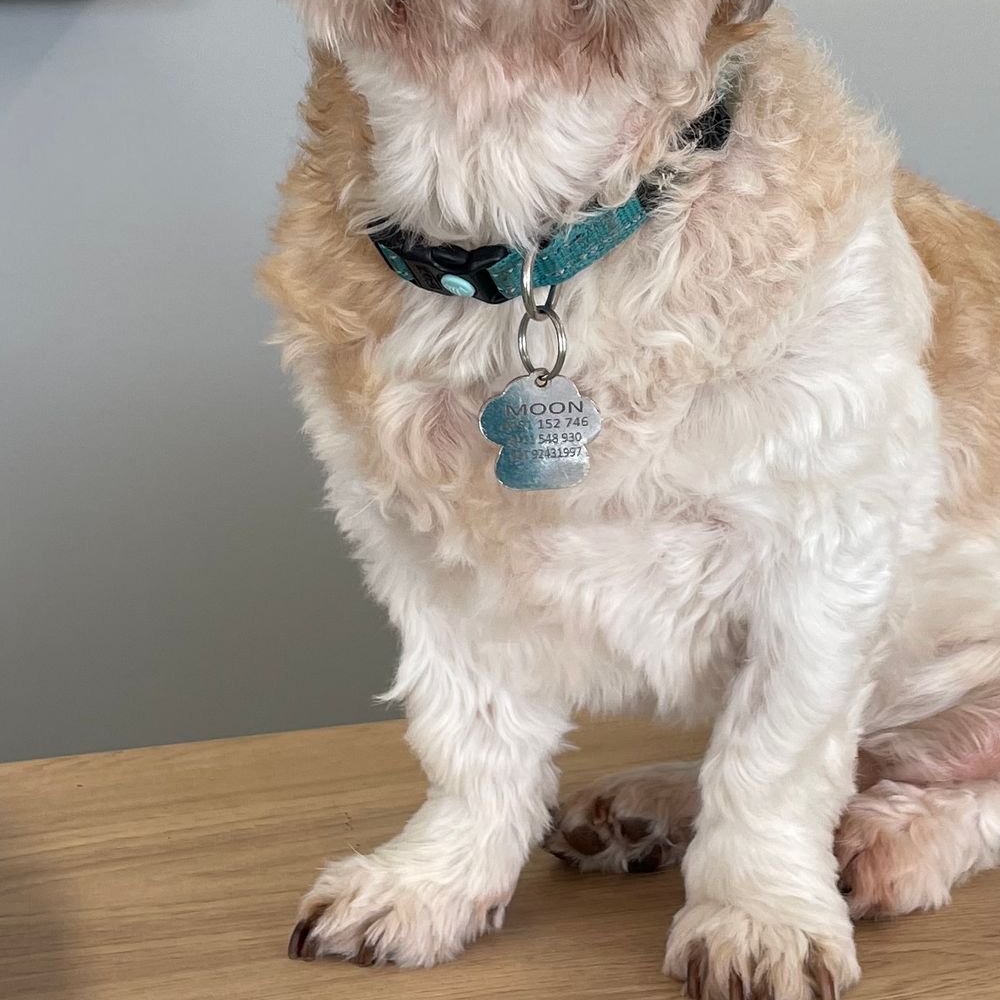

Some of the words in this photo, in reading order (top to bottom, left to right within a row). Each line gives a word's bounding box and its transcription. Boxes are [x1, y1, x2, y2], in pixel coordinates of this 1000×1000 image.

[505, 400, 584, 417] MOON
[538, 418, 561, 430] 152
[564, 416, 589, 428] 746
[538, 433, 558, 444] 548
[561, 431, 583, 443] 930
